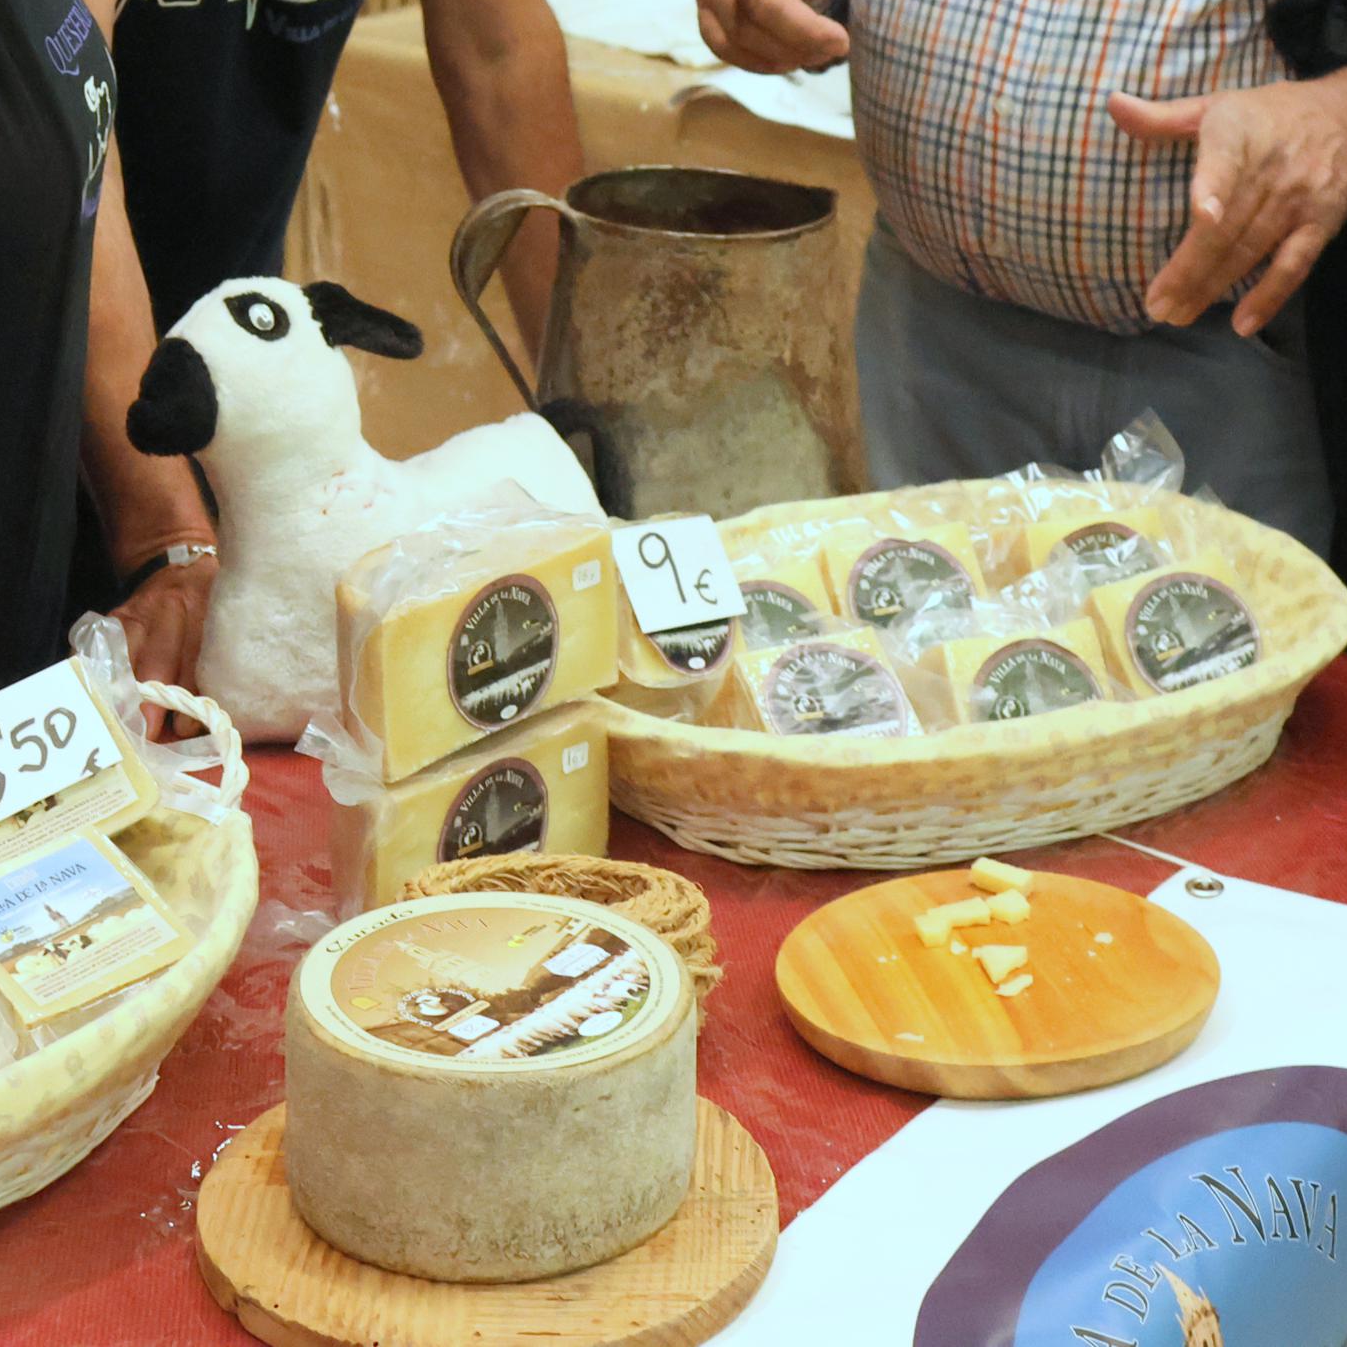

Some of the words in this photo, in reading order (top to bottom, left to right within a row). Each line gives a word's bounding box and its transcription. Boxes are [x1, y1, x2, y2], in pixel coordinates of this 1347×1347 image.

[49, 862, 88, 887] NAVA
[1102, 1254, 1163, 1324] DE
[1141, 1212, 1219, 1260] LA
[1189, 1165, 1338, 1262] NAVA
